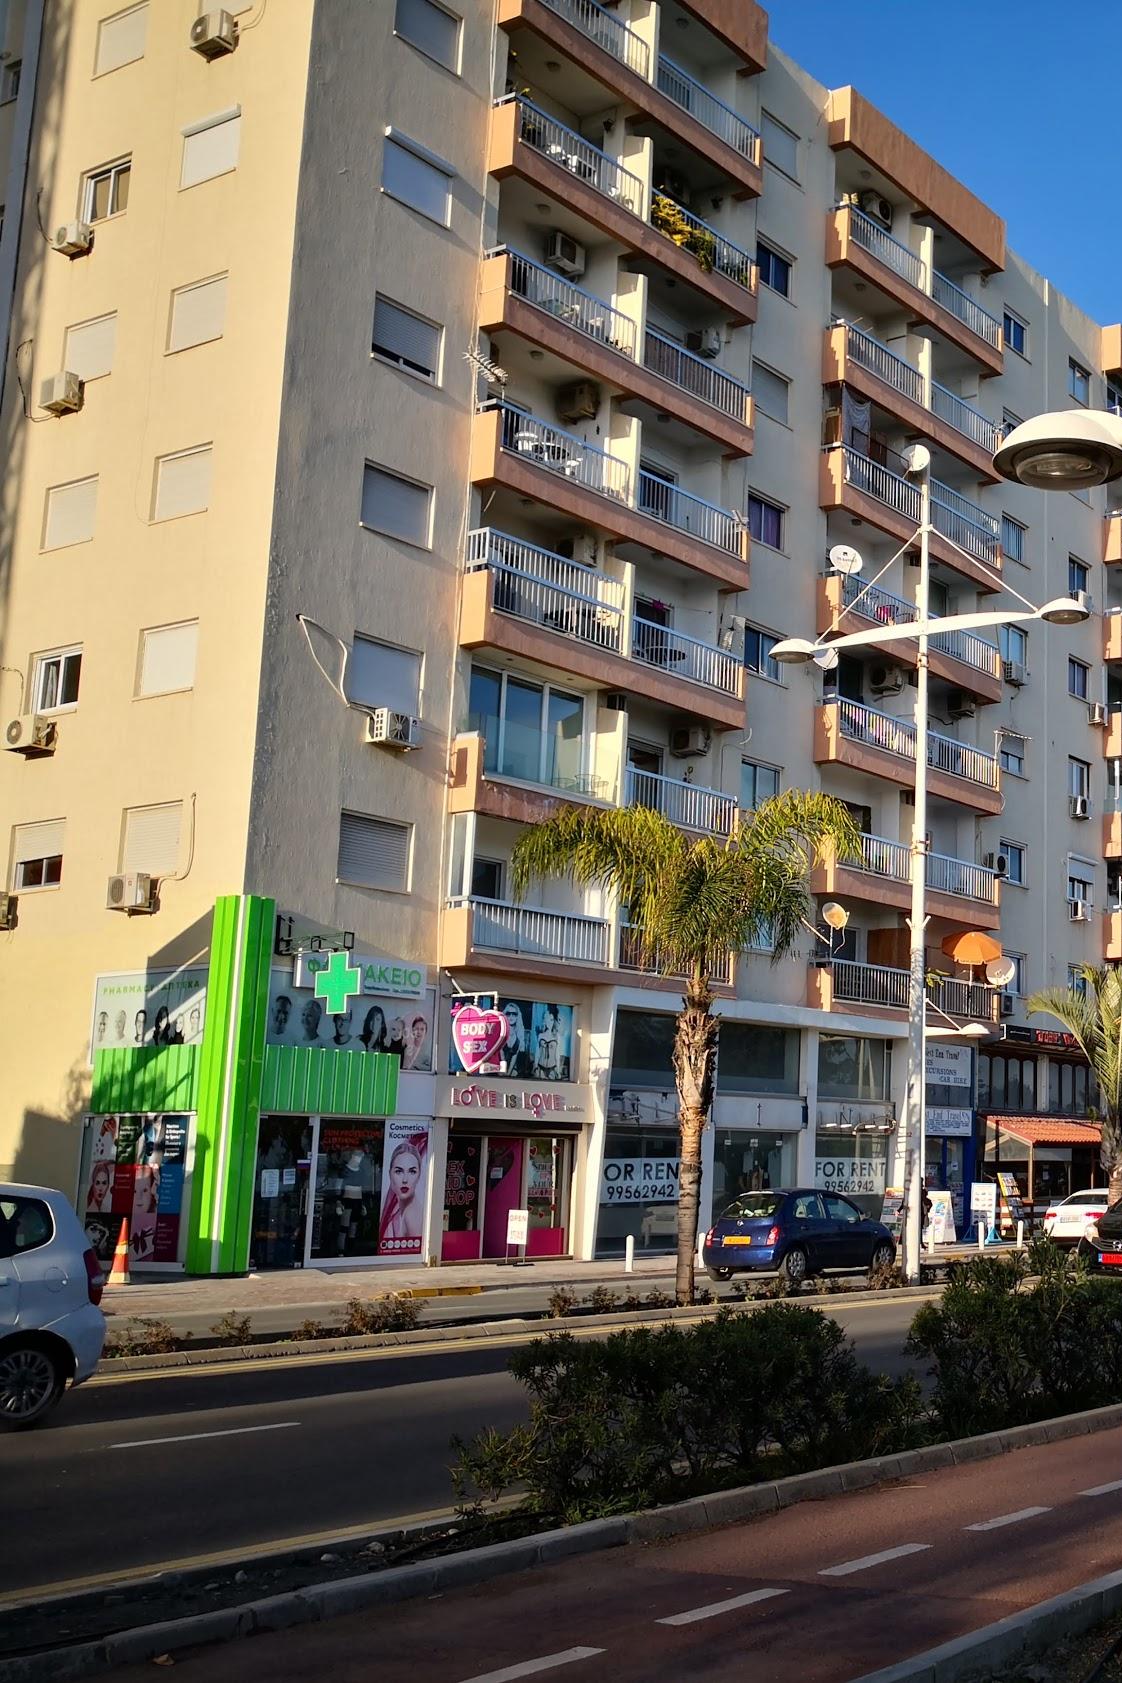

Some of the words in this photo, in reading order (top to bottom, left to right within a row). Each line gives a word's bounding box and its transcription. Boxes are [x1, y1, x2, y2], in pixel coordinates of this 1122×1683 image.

[307, 957, 421, 987] ΦΑΚΕΙΟ
[461, 1023, 495, 1036] BODY
[463, 1041, 488, 1053] SEX
[451, 1086, 497, 1106] LOVE
[504, 1094, 517, 1108] IS
[522, 1092, 562, 1112] LOVE
[389, 1123, 425, 1131] Cosmetics
[447, 1160, 466, 1176] EX
[604, 1163, 634, 1181] OR
[643, 1162, 680, 1181] REN
[815, 1161, 845, 1177] FOR
[851, 1161, 886, 1177] RENT
[607, 1184, 674, 1199] 99562942
[824, 1180, 875, 1193] 99562942
[446, 1190, 475, 1205] HOP
